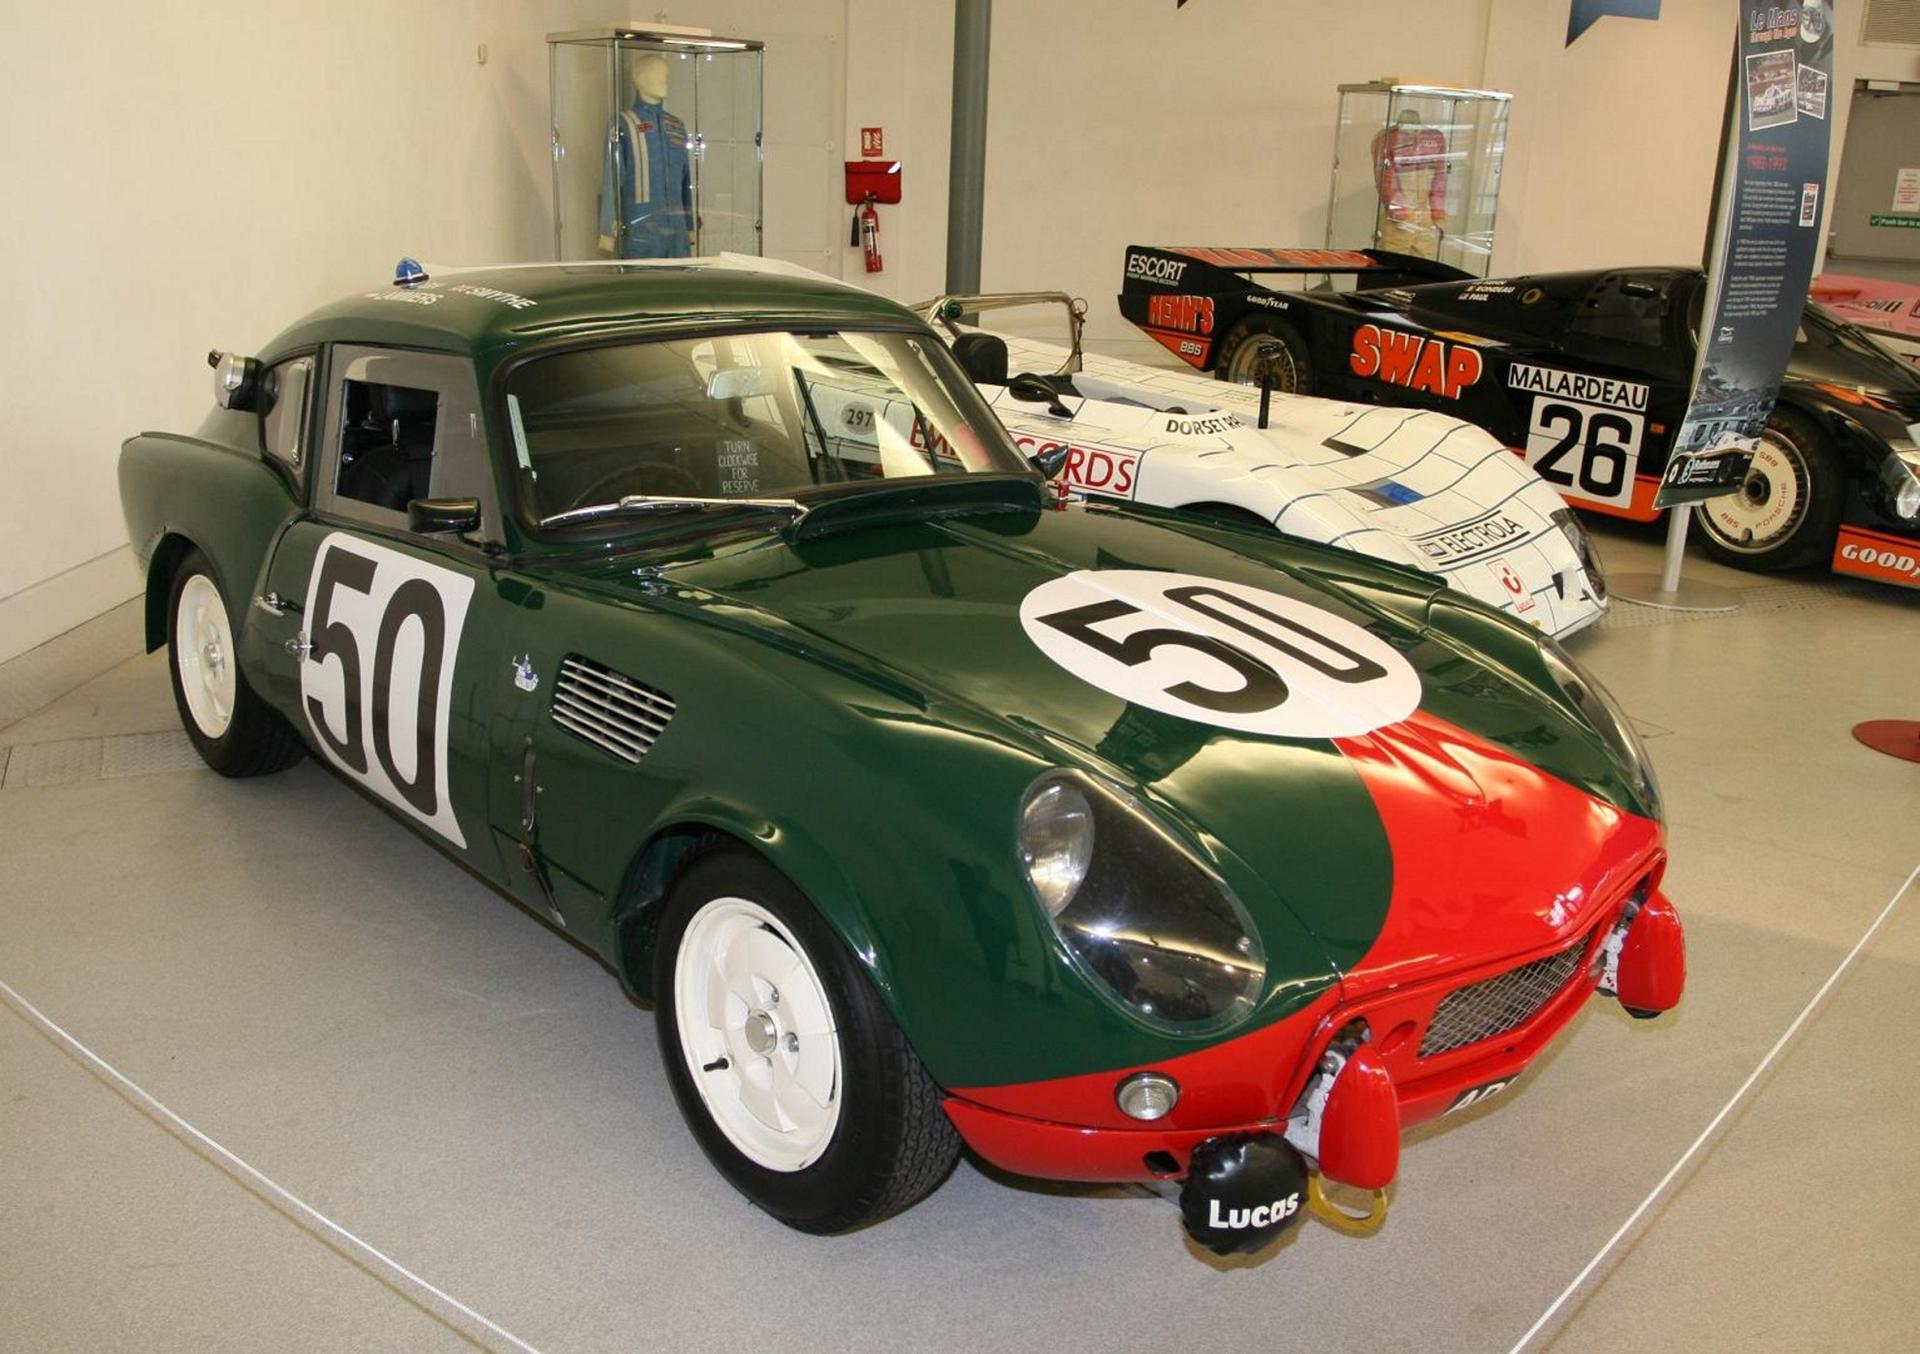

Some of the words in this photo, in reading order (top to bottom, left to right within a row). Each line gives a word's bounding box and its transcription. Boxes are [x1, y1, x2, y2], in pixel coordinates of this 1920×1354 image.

[1128, 254, 1187, 281] ESCORT
[1149, 295, 1215, 335] HENN'S
[1179, 341, 1202, 356] BBS
[1350, 324, 1483, 400] SWAP
[1510, 364, 1647, 409] MALARDEAU
[846, 408, 874, 428] 297
[1166, 419, 1227, 435] DORSET
[723, 440, 751, 454] TURN
[1533, 403, 1633, 498] 26
[722, 479, 759, 494] RESERVE
[731, 467, 750, 480] FOR
[1439, 516, 1524, 553] ELECTROLA
[1034, 585, 1389, 714] 50
[305, 544, 447, 818] 50
[1209, 1192, 1300, 1229] Lucas
